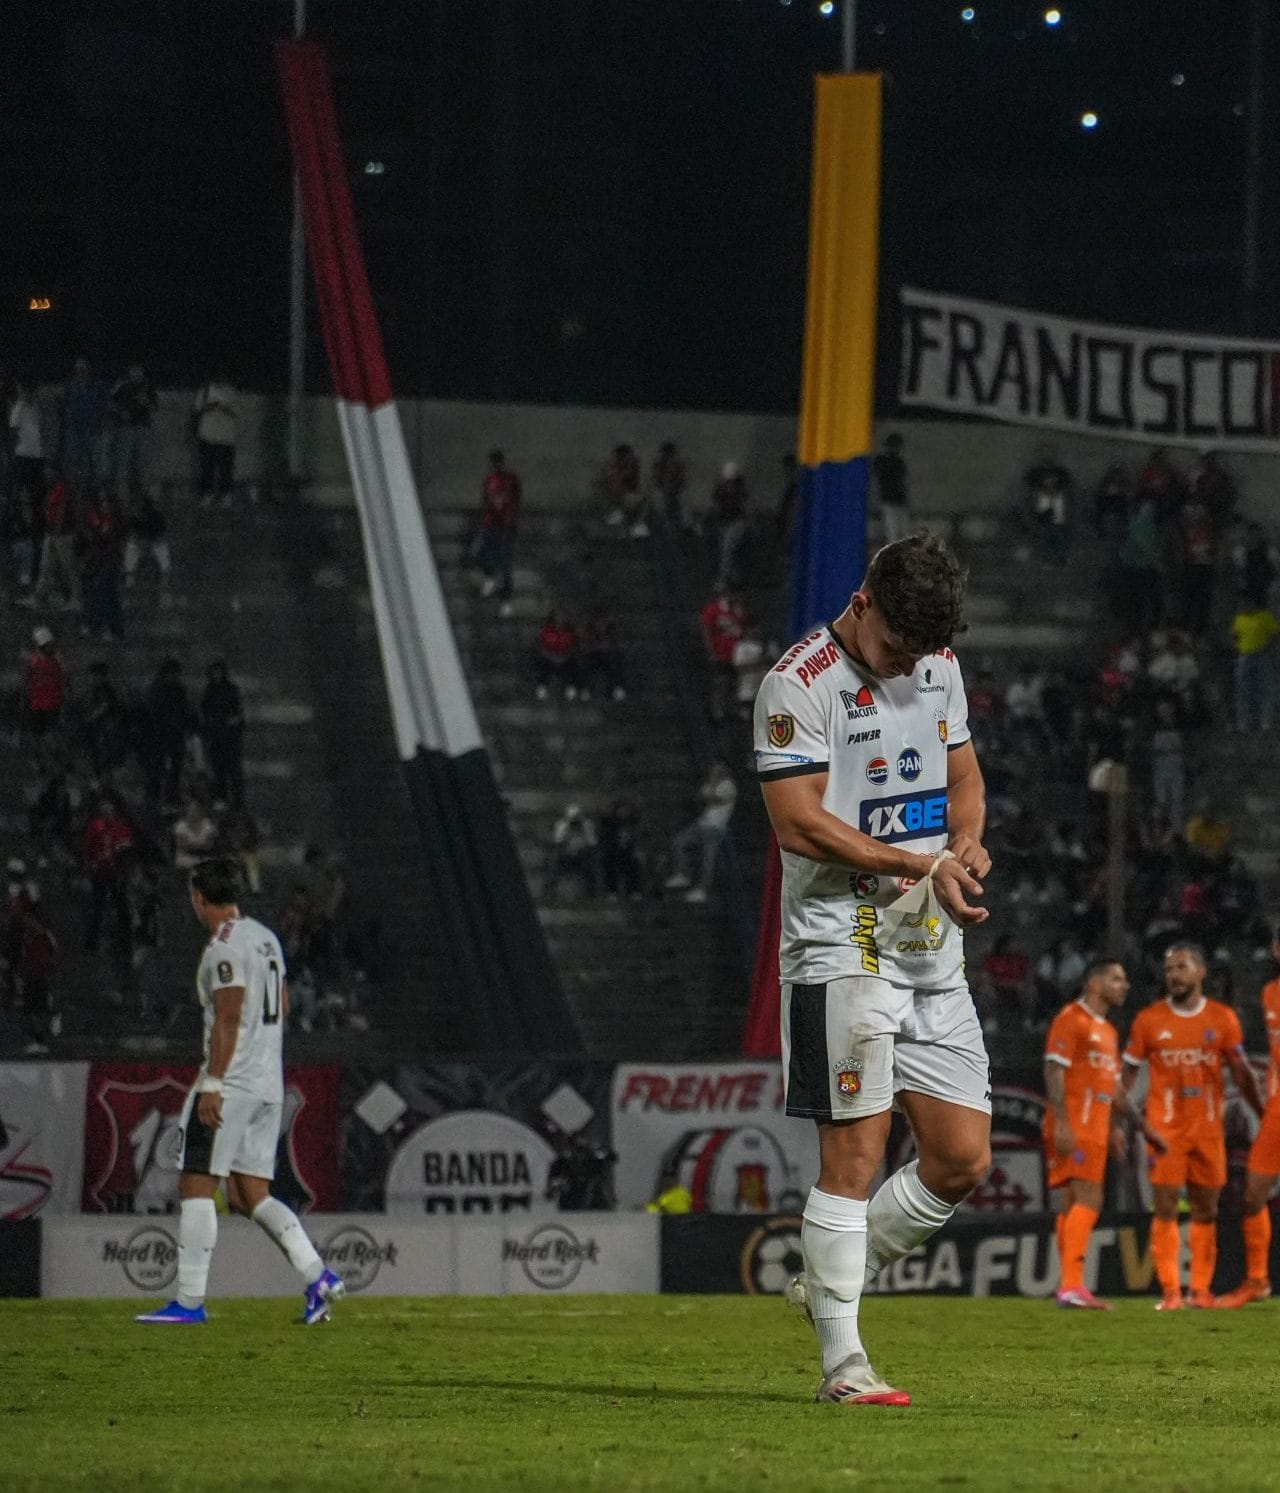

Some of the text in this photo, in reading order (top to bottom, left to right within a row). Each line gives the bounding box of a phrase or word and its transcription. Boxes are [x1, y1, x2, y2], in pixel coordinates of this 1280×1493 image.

[847, 706, 879, 720] MACUTO
[897, 754, 923, 773] PAN
[619, 1072, 768, 1114] FRENTE
[424, 1151, 533, 1186] BANDA
[152, 1239, 179, 1266] Ro
[353, 1240, 398, 1267] Rock
[503, 1238, 600, 1265] Hard Rock
[867, 1239, 962, 1292] IGA
